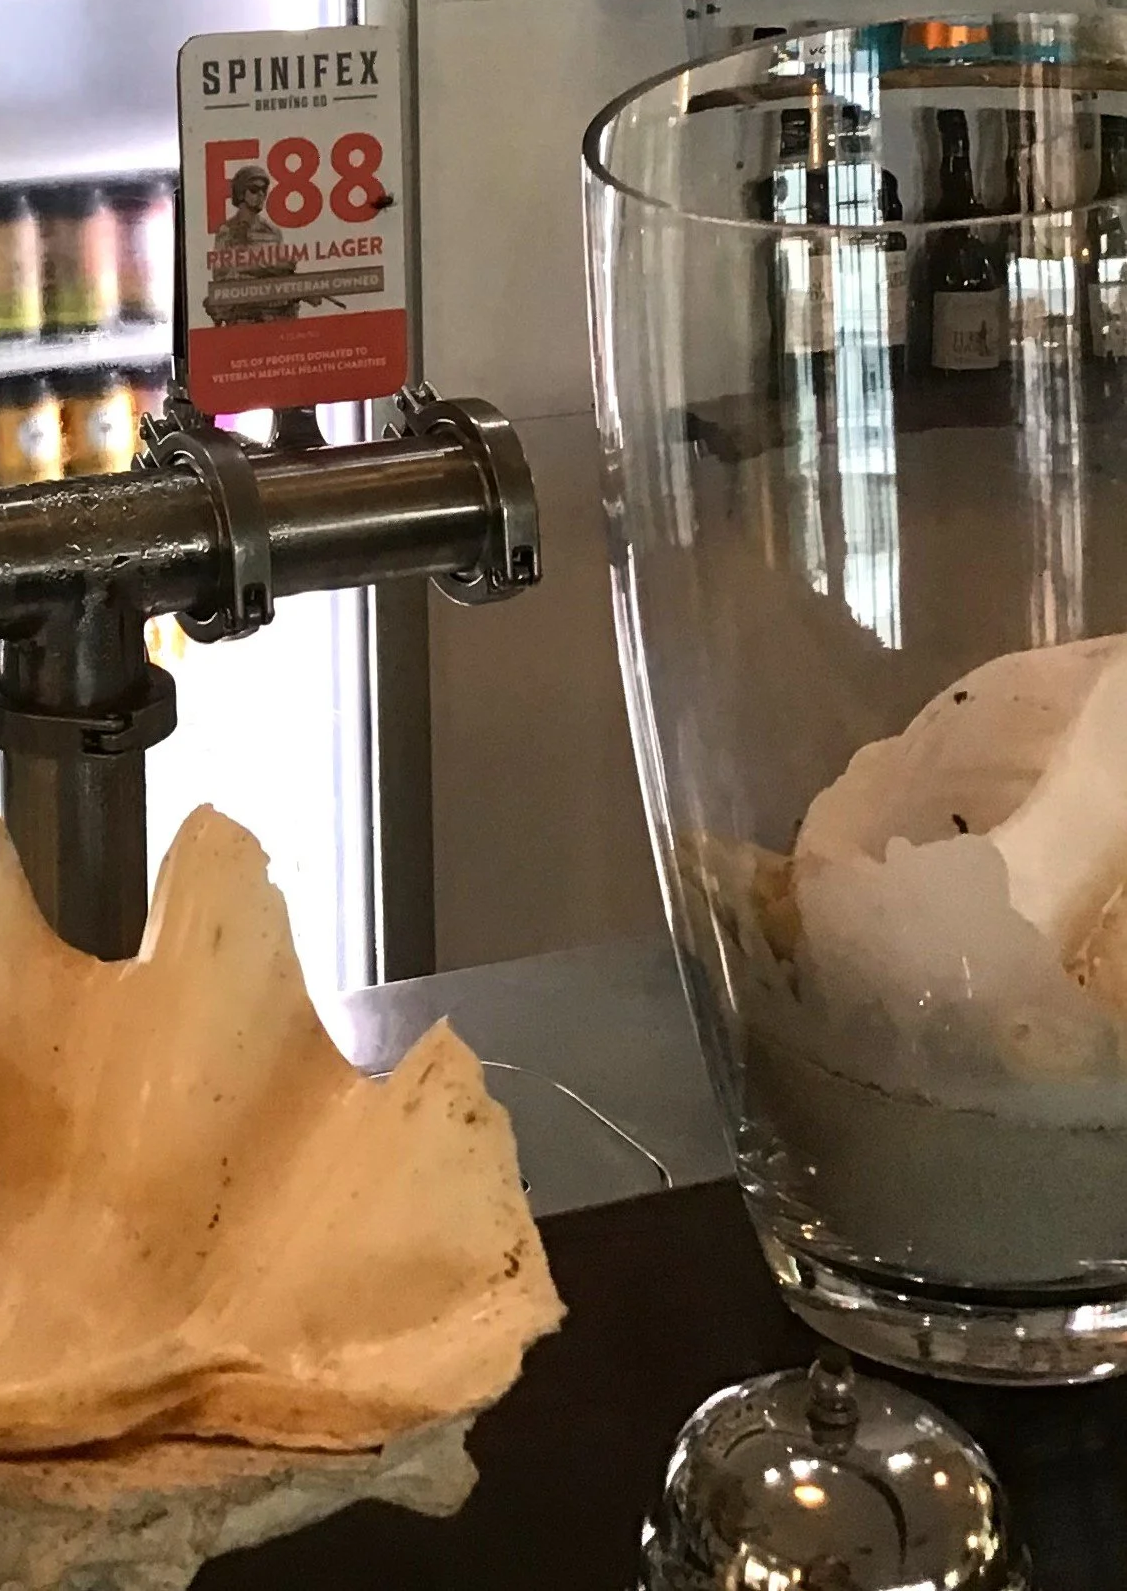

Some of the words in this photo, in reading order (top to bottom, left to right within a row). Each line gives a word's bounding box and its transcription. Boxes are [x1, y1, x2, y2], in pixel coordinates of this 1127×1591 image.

[202, 50, 379, 96] SPINIFEX
[254, 95, 308, 112] BREWING
[204, 131, 387, 235] F88
[206, 242, 310, 271] PREMIUM
[315, 236, 384, 260] LAGER
[214, 283, 272, 300] PROUDLY
[273, 279, 330, 294] VETERAN
[332, 274, 379, 288] OWNED
[265, 352, 306, 366] PROFITS
[307, 348, 353, 362] DONATED
[355, 346, 368, 357] TO
[212, 370, 257, 384] VETERAN
[258, 366, 297, 380] MENTAL
[298, 362, 335, 376] HEALTH
[337, 357, 387, 371] CHARITIES
